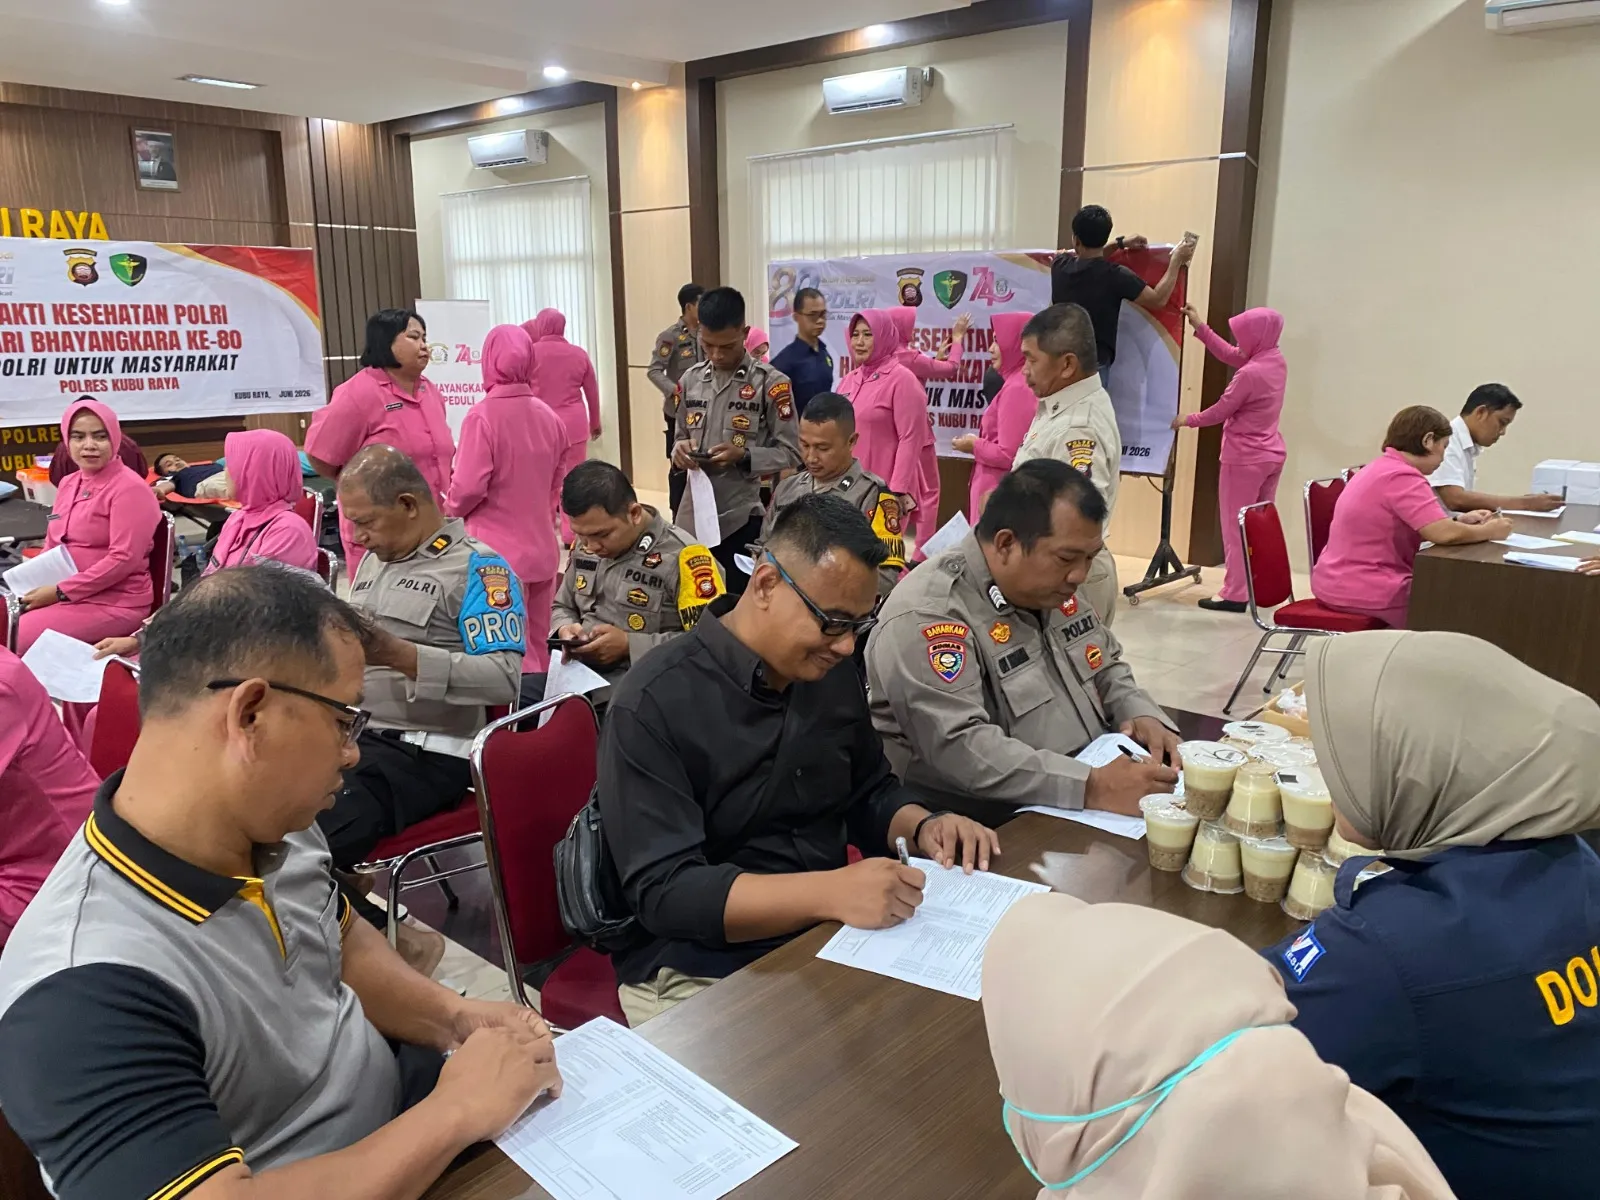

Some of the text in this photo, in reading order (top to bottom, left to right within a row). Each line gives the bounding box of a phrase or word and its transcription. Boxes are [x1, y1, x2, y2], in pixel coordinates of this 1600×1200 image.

[20, 208, 109, 240] RAYA
[52, 304, 169, 325] KESEHATAN
[174, 304, 228, 325] POLRI
[0, 329, 242, 353] RI BHAYANGKARA KE-80
[0, 354, 239, 376] OLRI UNTUK MASYARAKAT
[60, 376, 180, 393] POLRES KUBU RAYA
[234, 391, 251, 400] KUBU
[294, 389, 311, 398] 2026
[728, 401, 760, 412] POLRI
[938, 413, 967, 429] KUBU
[1129, 446, 1151, 457] 2026
[397, 578, 437, 596] POLRI
[624, 569, 664, 588] POLRI
[463, 611, 520, 650] PRO
[926, 624, 965, 638] BAHARKAM
[1061, 615, 1095, 642] POLRI
